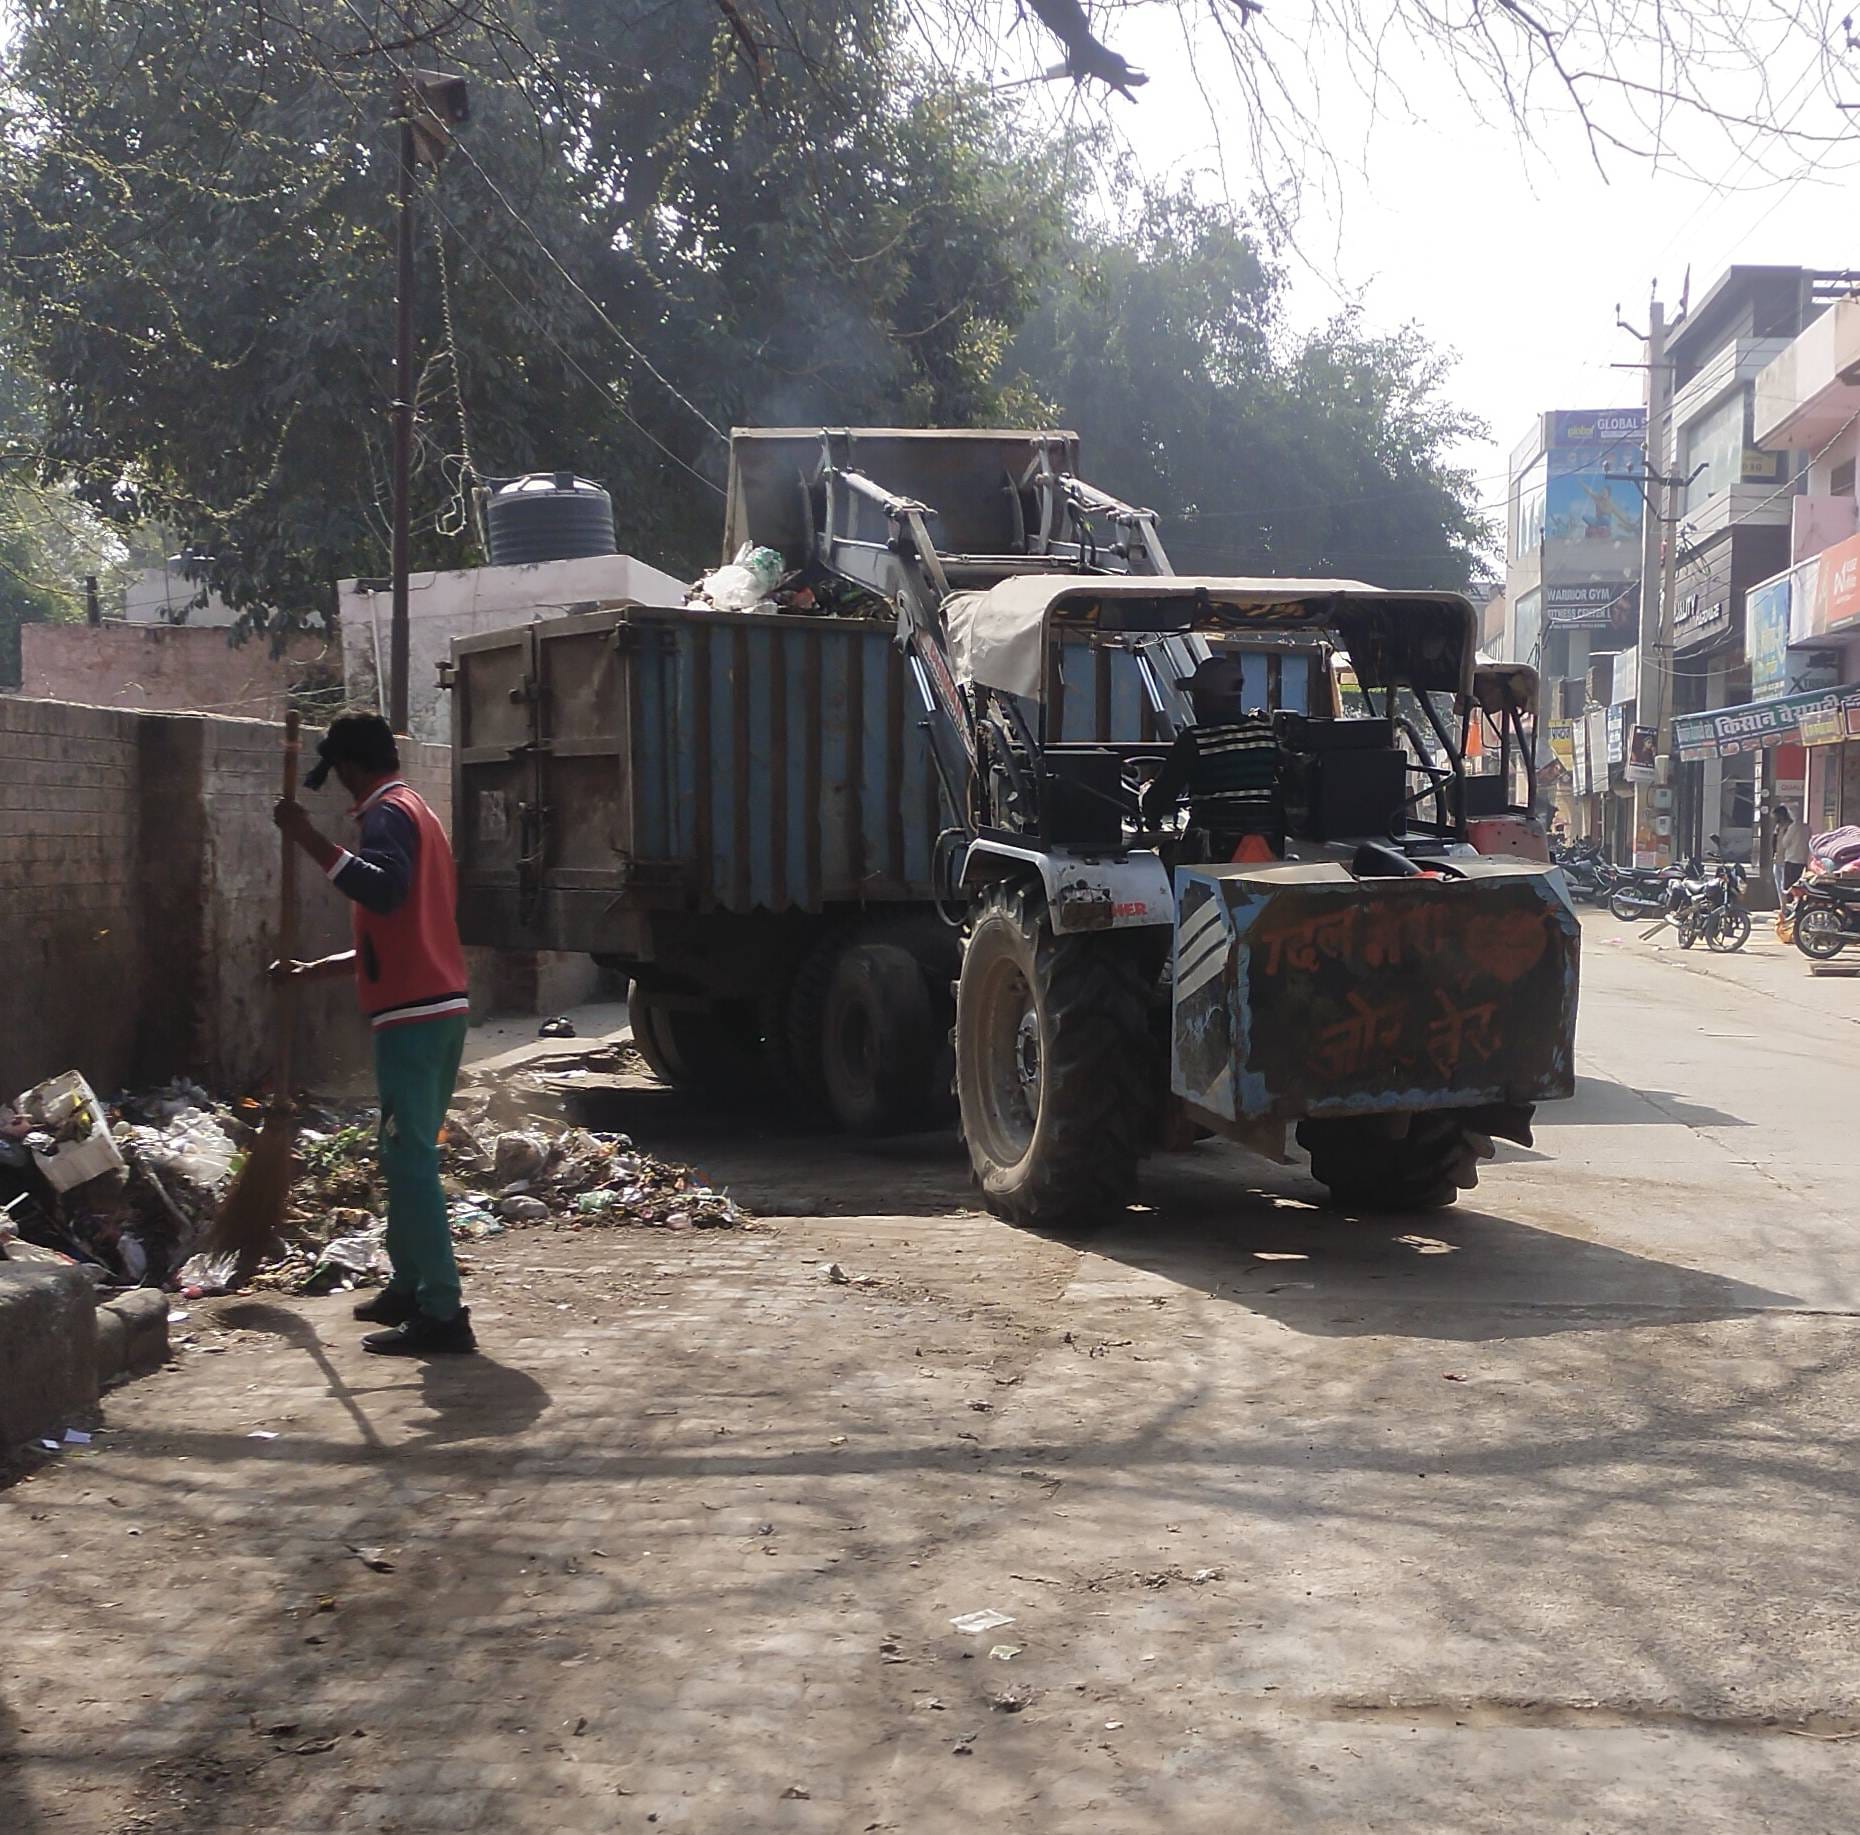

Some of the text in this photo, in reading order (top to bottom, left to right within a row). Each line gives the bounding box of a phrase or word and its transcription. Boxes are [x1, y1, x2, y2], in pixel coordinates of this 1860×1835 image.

[1597, 417, 1638, 430] GLOBAL
[1588, 588, 1610, 600] GYM
[1715, 710, 1777, 737] किसान
